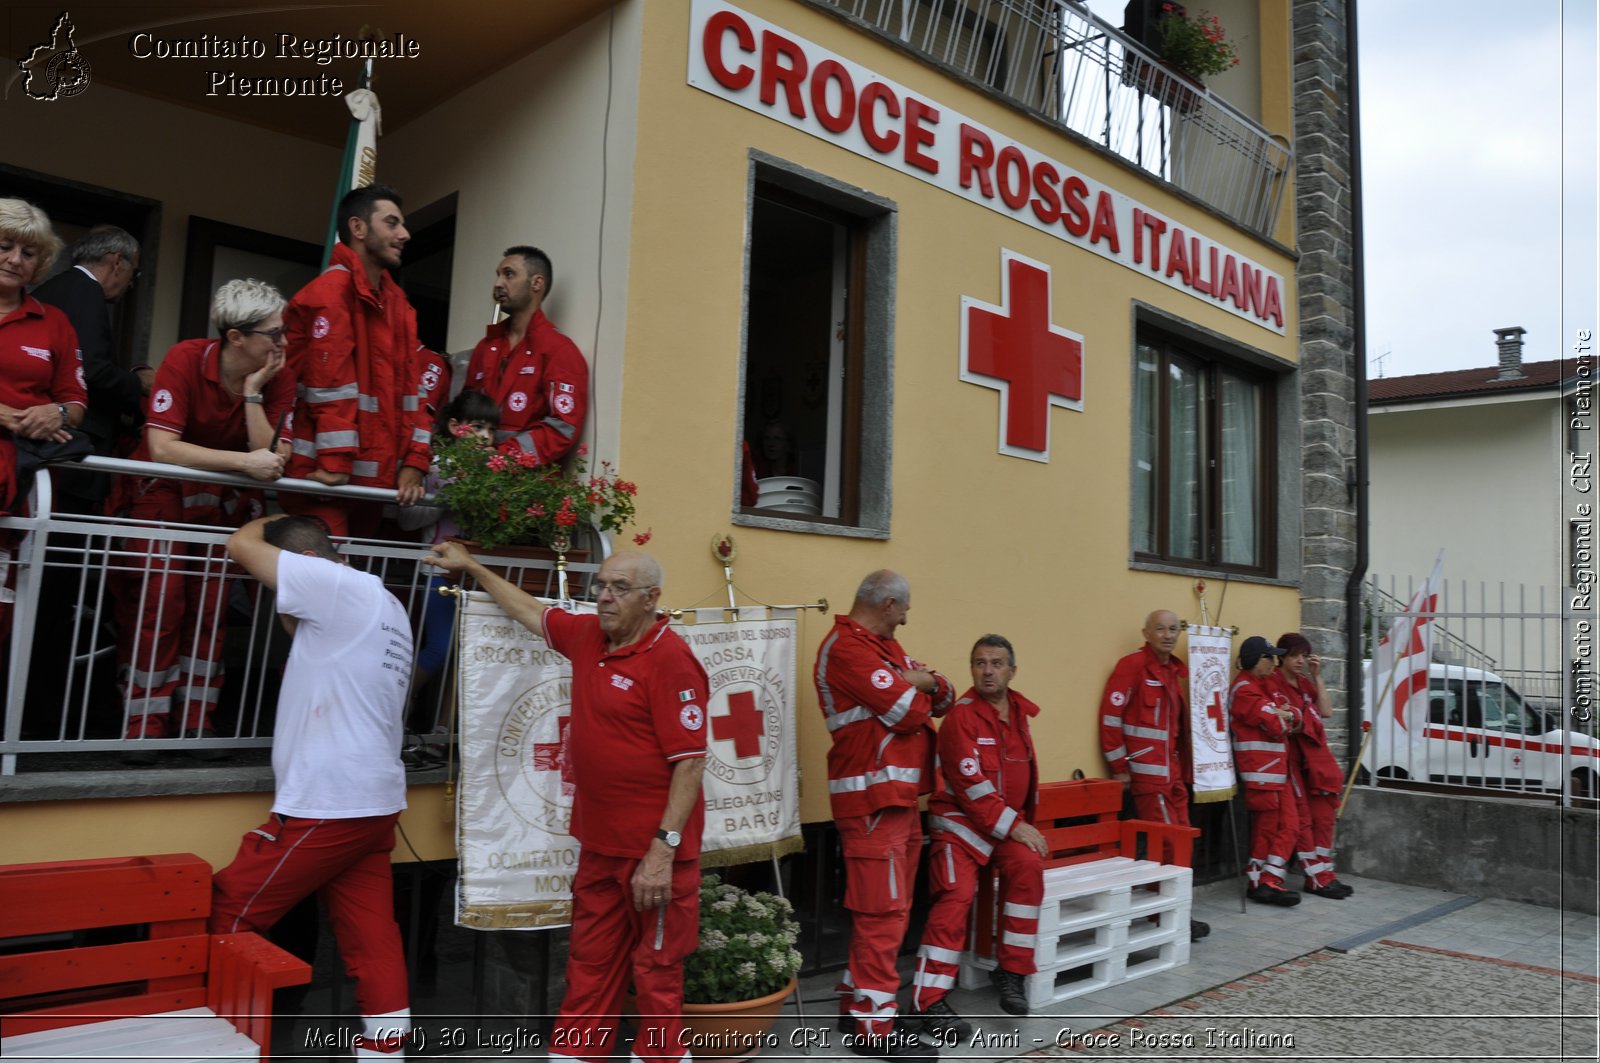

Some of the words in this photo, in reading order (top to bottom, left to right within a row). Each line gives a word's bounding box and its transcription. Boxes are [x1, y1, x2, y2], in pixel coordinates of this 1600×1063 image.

[702, 10, 939, 175] CROCE
[959, 122, 1120, 254] ROSSA
[1133, 207, 1285, 328] ITALIANA
[741, 629, 757, 641] DEL
[473, 646, 527, 666] CROCE
[531, 650, 571, 666] ROS
[703, 646, 755, 672] ROSSA
[501, 682, 572, 758] CONVENZION
[487, 848, 575, 870] COMITATO
